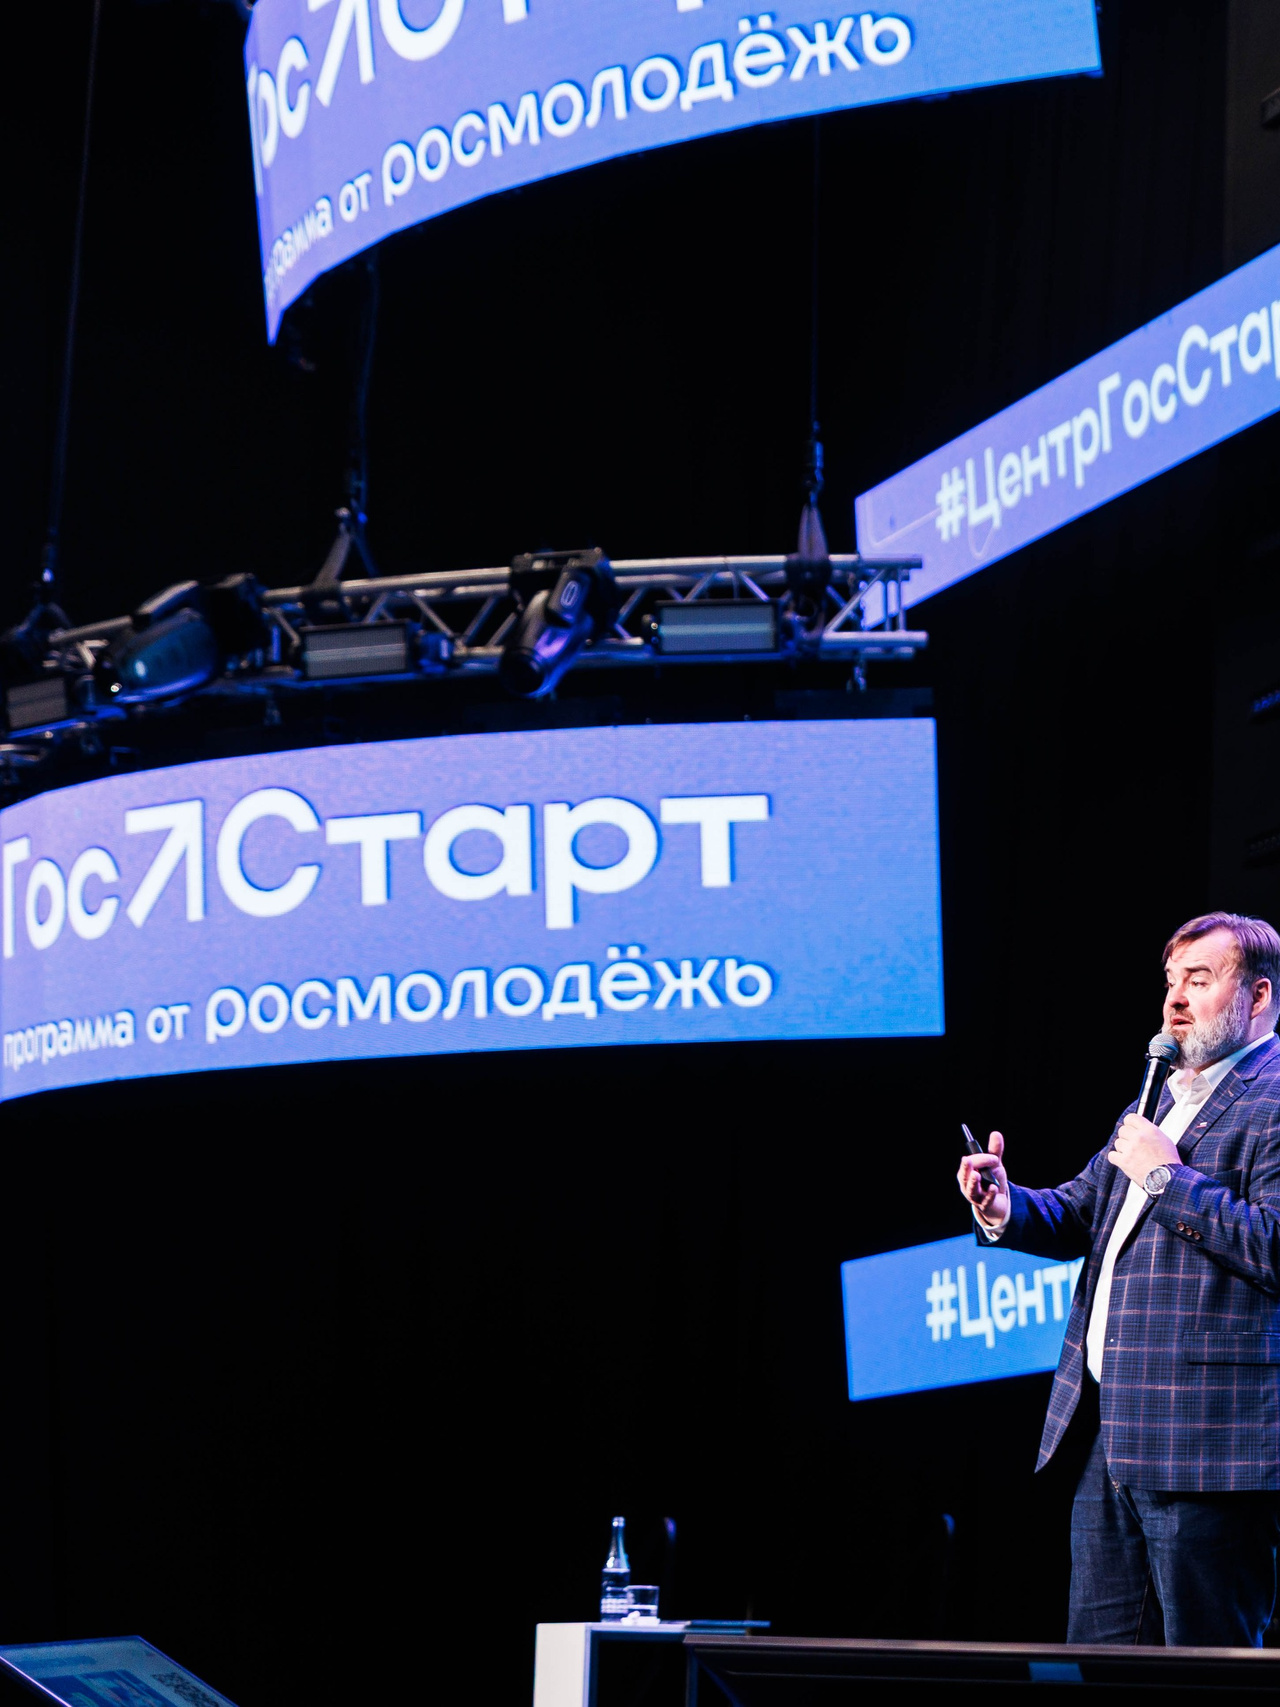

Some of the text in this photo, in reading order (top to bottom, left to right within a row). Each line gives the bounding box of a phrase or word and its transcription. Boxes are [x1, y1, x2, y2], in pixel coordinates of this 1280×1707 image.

[339, 172, 372, 223] от
[382, 14, 911, 206] росмолодёжь
[3, 945, 773, 1072] программа от росмолодёжь
